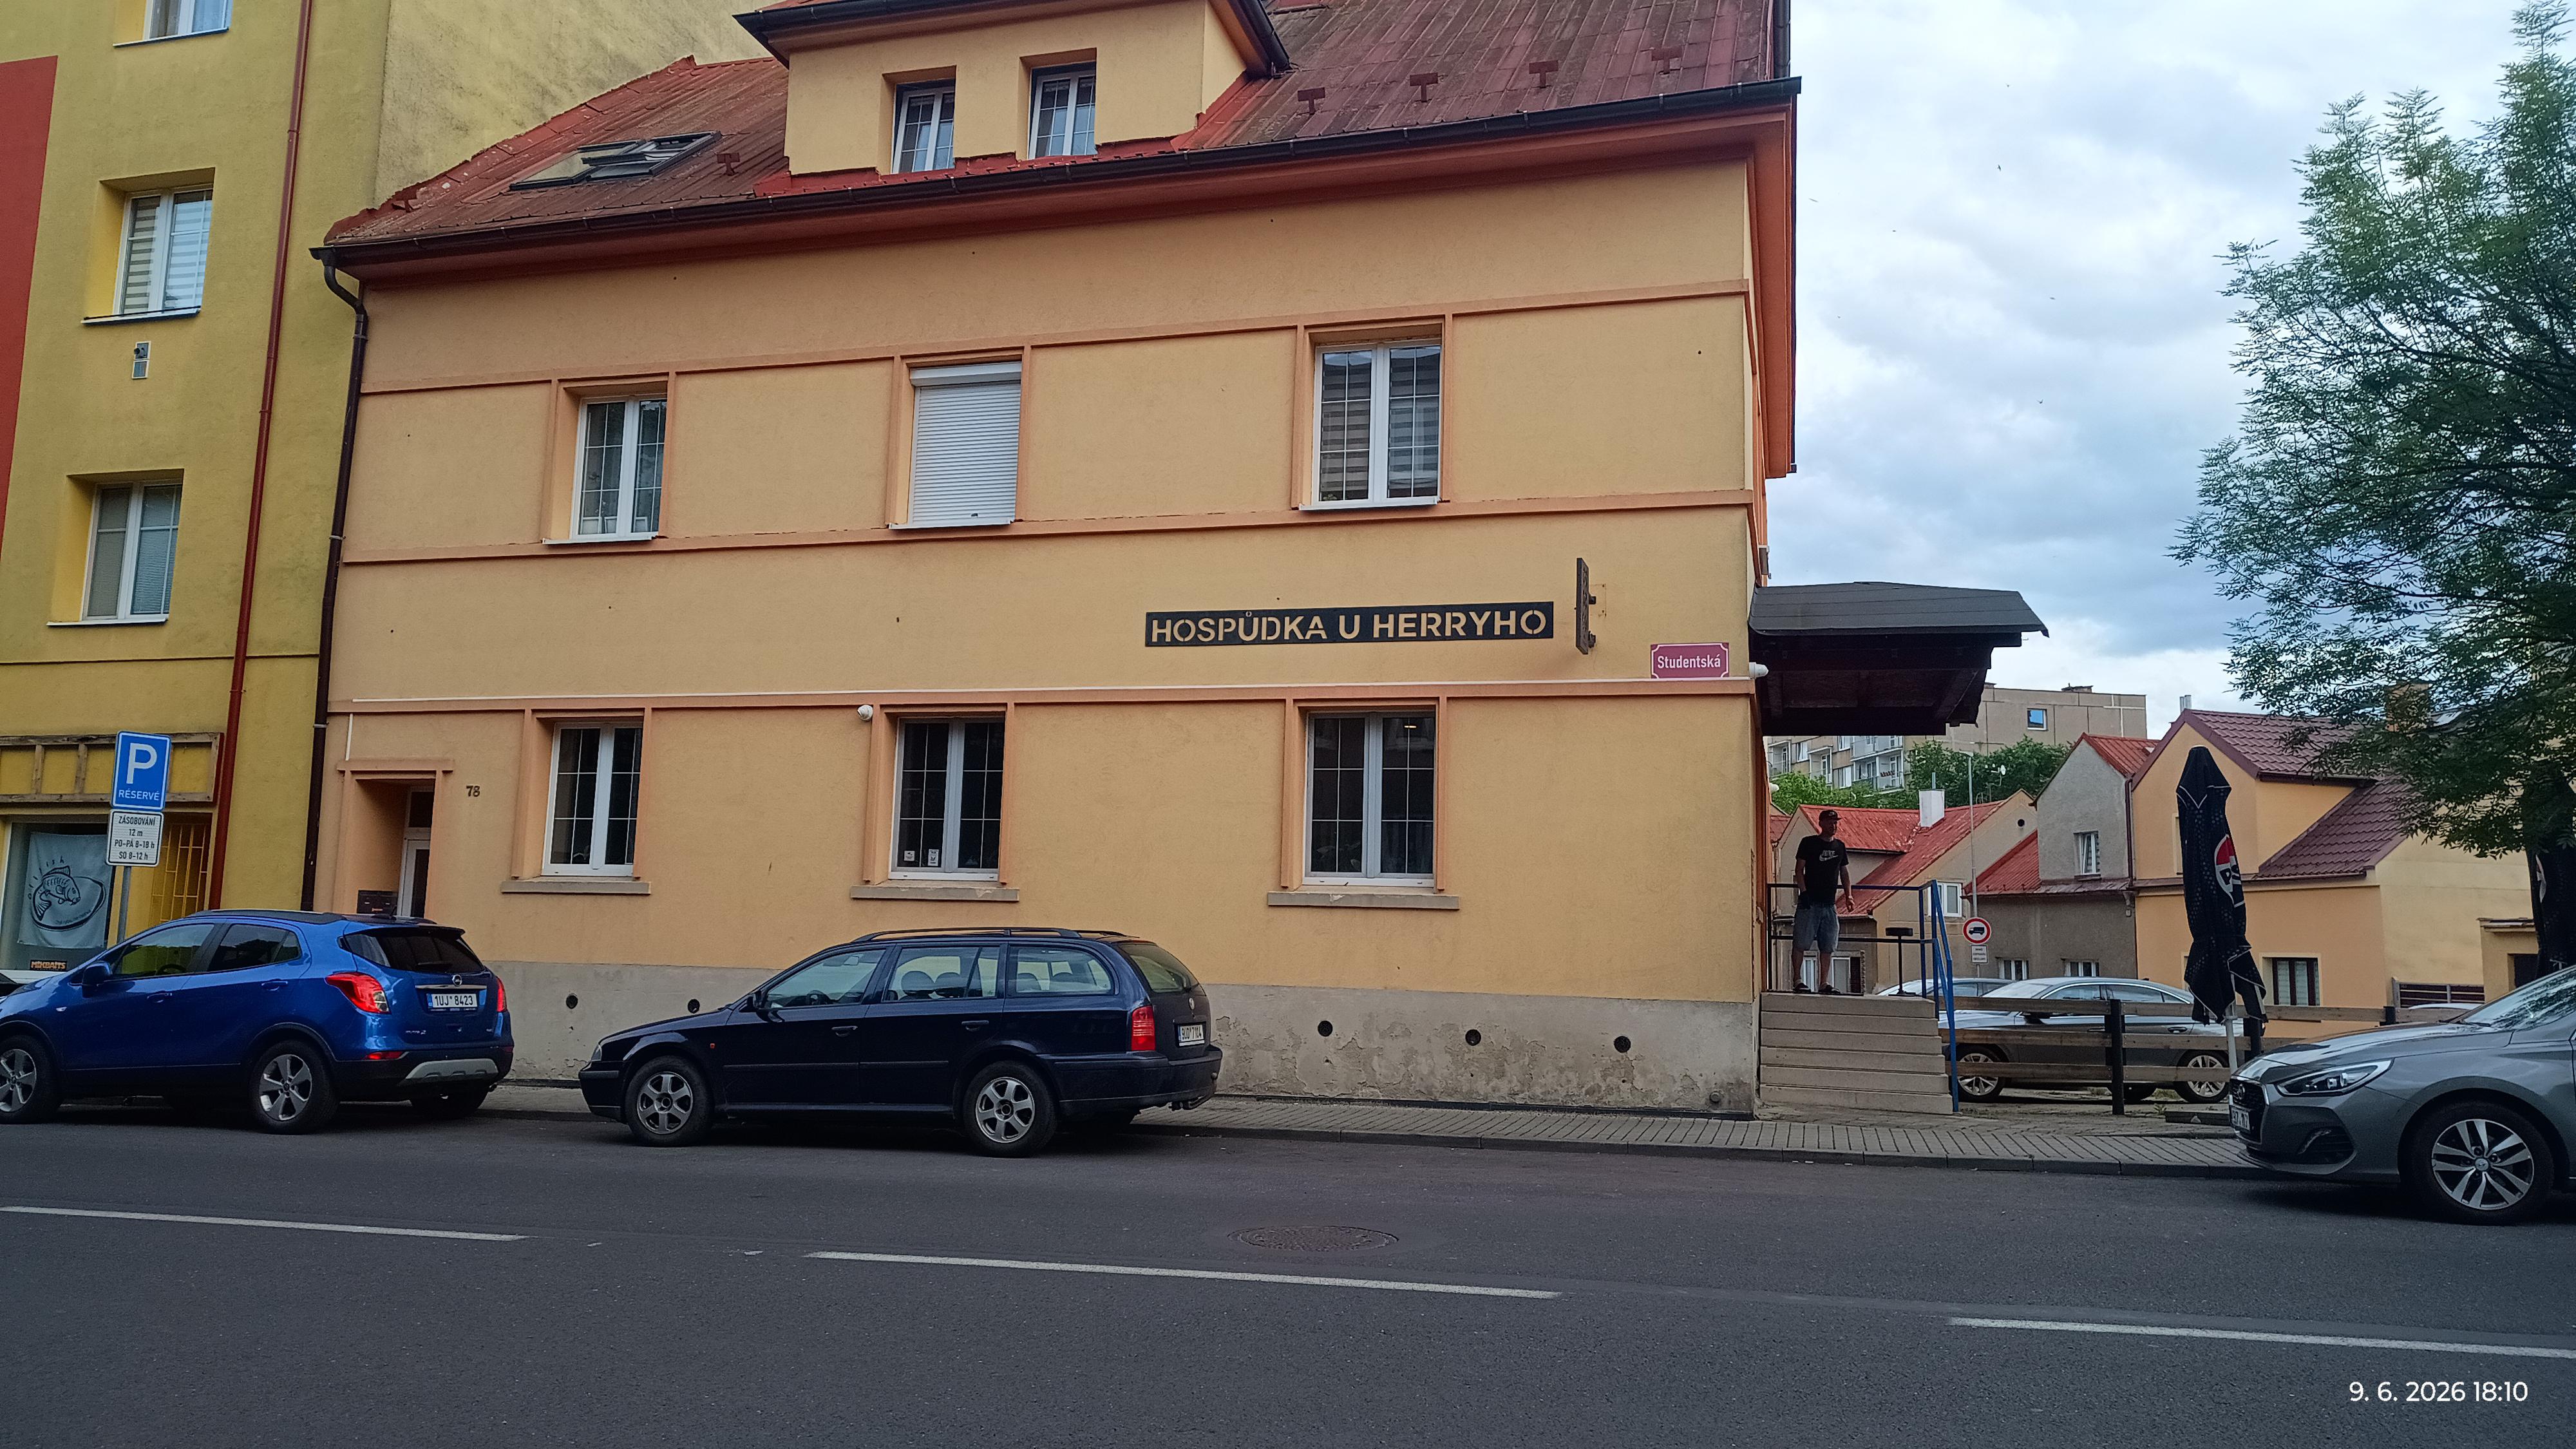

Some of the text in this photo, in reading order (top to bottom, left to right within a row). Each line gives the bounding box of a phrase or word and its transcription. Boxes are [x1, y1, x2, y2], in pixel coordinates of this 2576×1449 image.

[1151, 609, 1546, 642] HOSPŮDKA U HERRYHO
[1657, 654, 1721, 668] Studentská
[126, 743, 158, 784] P
[118, 788, 160, 801] RÉSERVÉ
[466, 785, 480, 797] 78
[118, 815, 156, 826] ZÁSOBOVÁNÍ
[129, 828, 136, 837] 12
[115, 838, 133, 848] PO-PÁ
[135, 840, 149, 849] 8-18
[129, 851, 143, 860] 8-12
[144, 852, 148, 860] h
[434, 995, 449, 1006] 1UJ
[454, 995, 473, 1006] 8423
